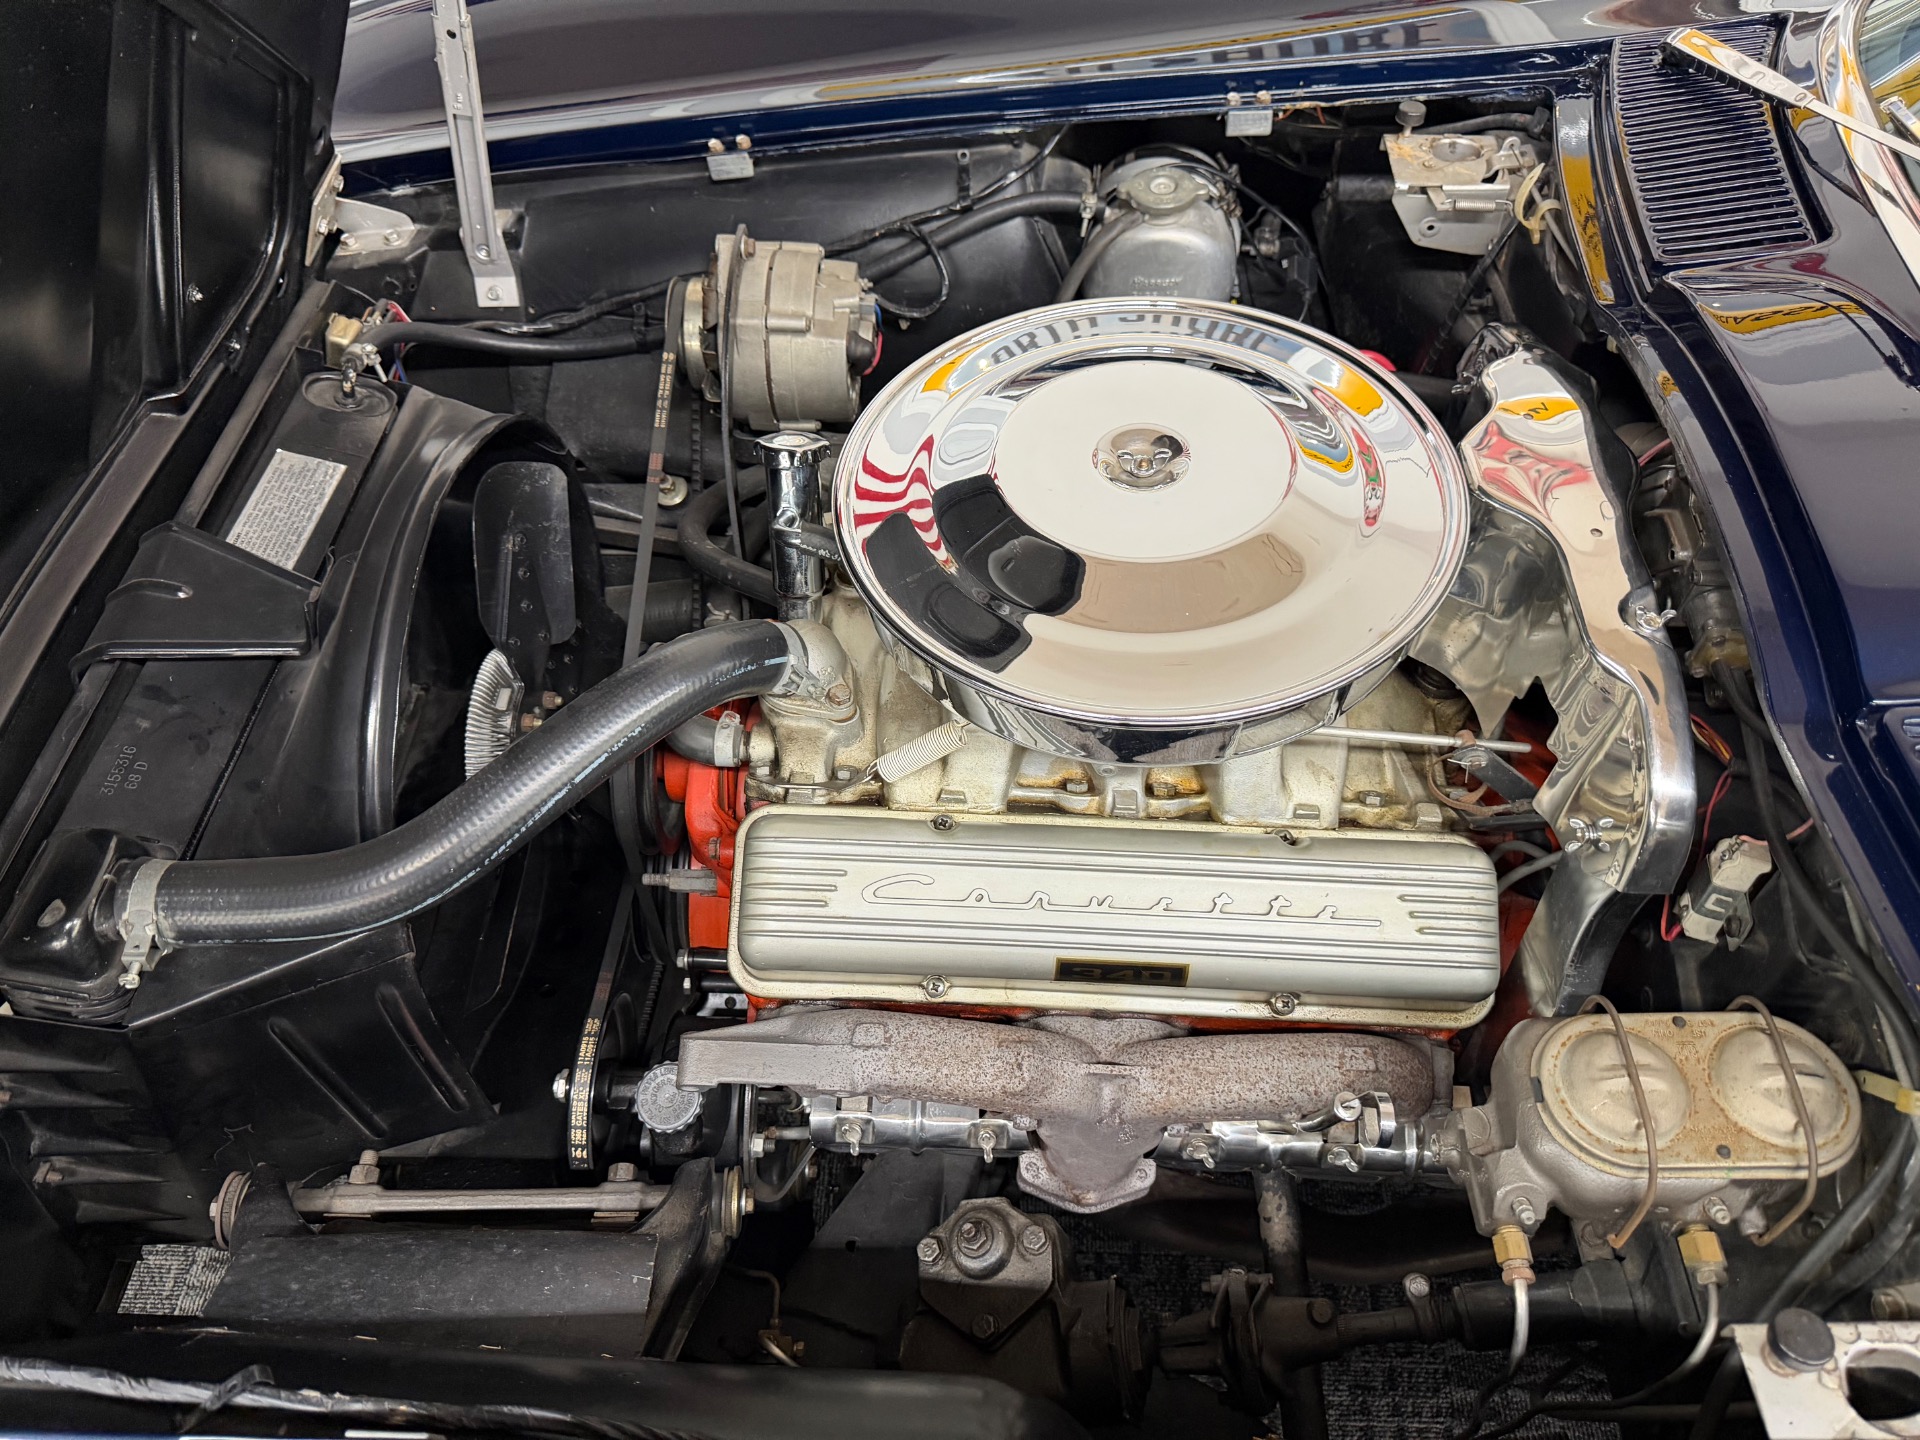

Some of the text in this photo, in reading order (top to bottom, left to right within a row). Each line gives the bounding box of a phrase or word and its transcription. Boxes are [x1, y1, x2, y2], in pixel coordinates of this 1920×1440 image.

[100, 746, 136, 795] 3155316
[124, 762, 148, 789] 68 D
[861, 873, 1382, 928] Corvette
[1072, 967, 1172, 983] 340
[576, 1101, 584, 1126] GATES
